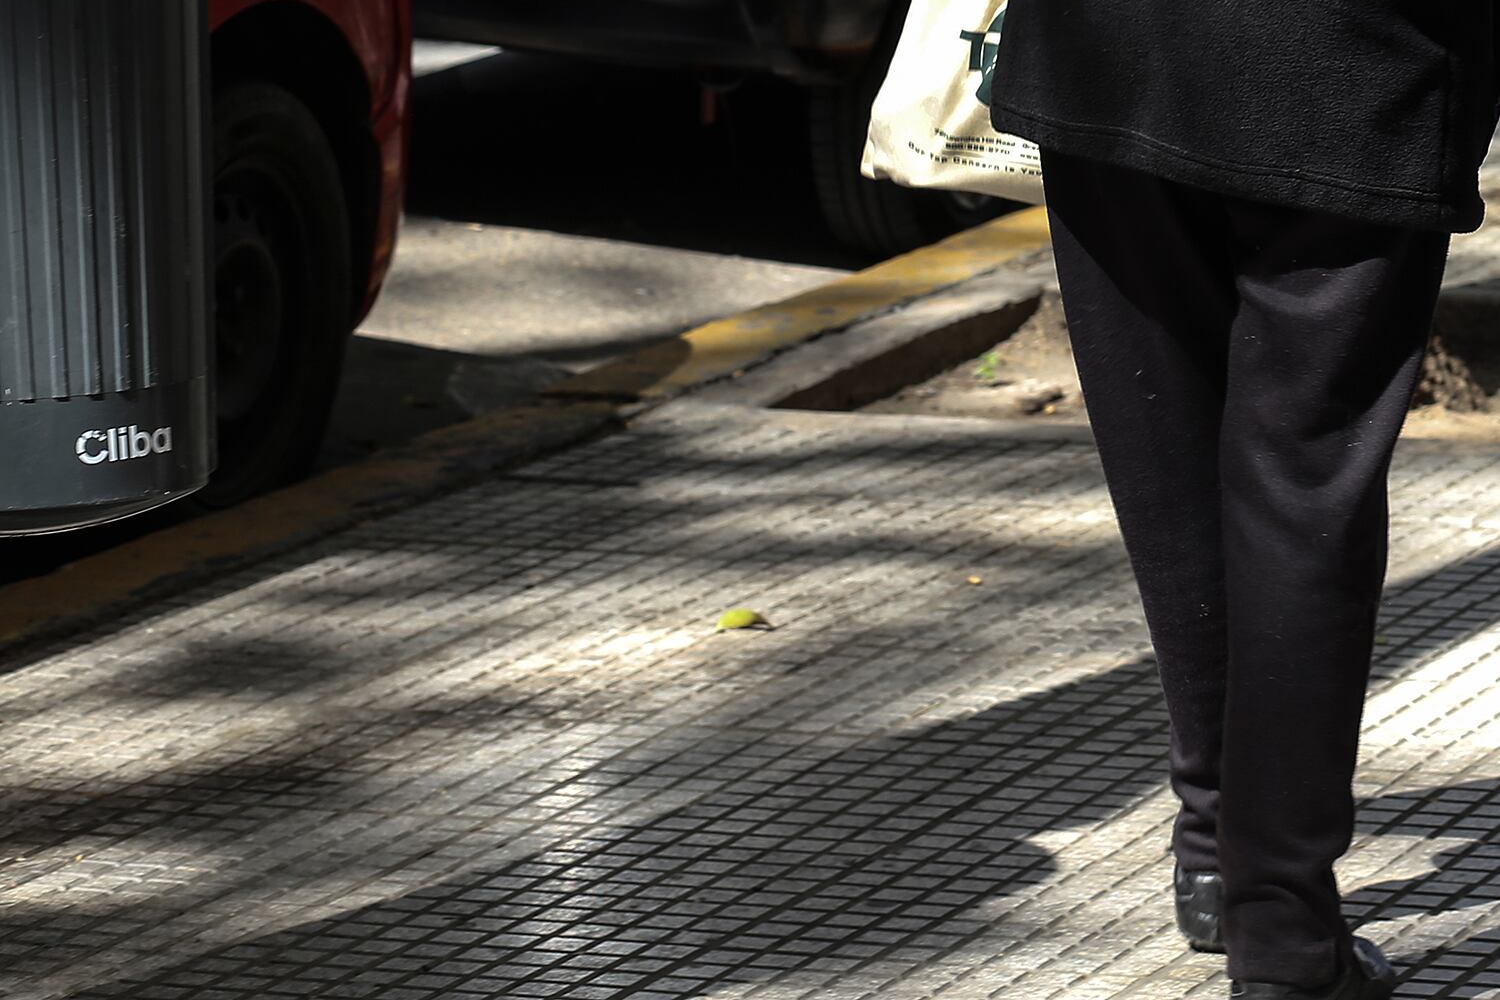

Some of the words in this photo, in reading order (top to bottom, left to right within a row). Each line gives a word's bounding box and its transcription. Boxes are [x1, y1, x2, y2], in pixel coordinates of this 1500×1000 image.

[908, 141, 925, 155] Our
[930, 153, 948, 164] Top
[953, 156, 1000, 171] Concern
[995, 137, 1016, 147] Road
[76, 425, 172, 465] Cliba
